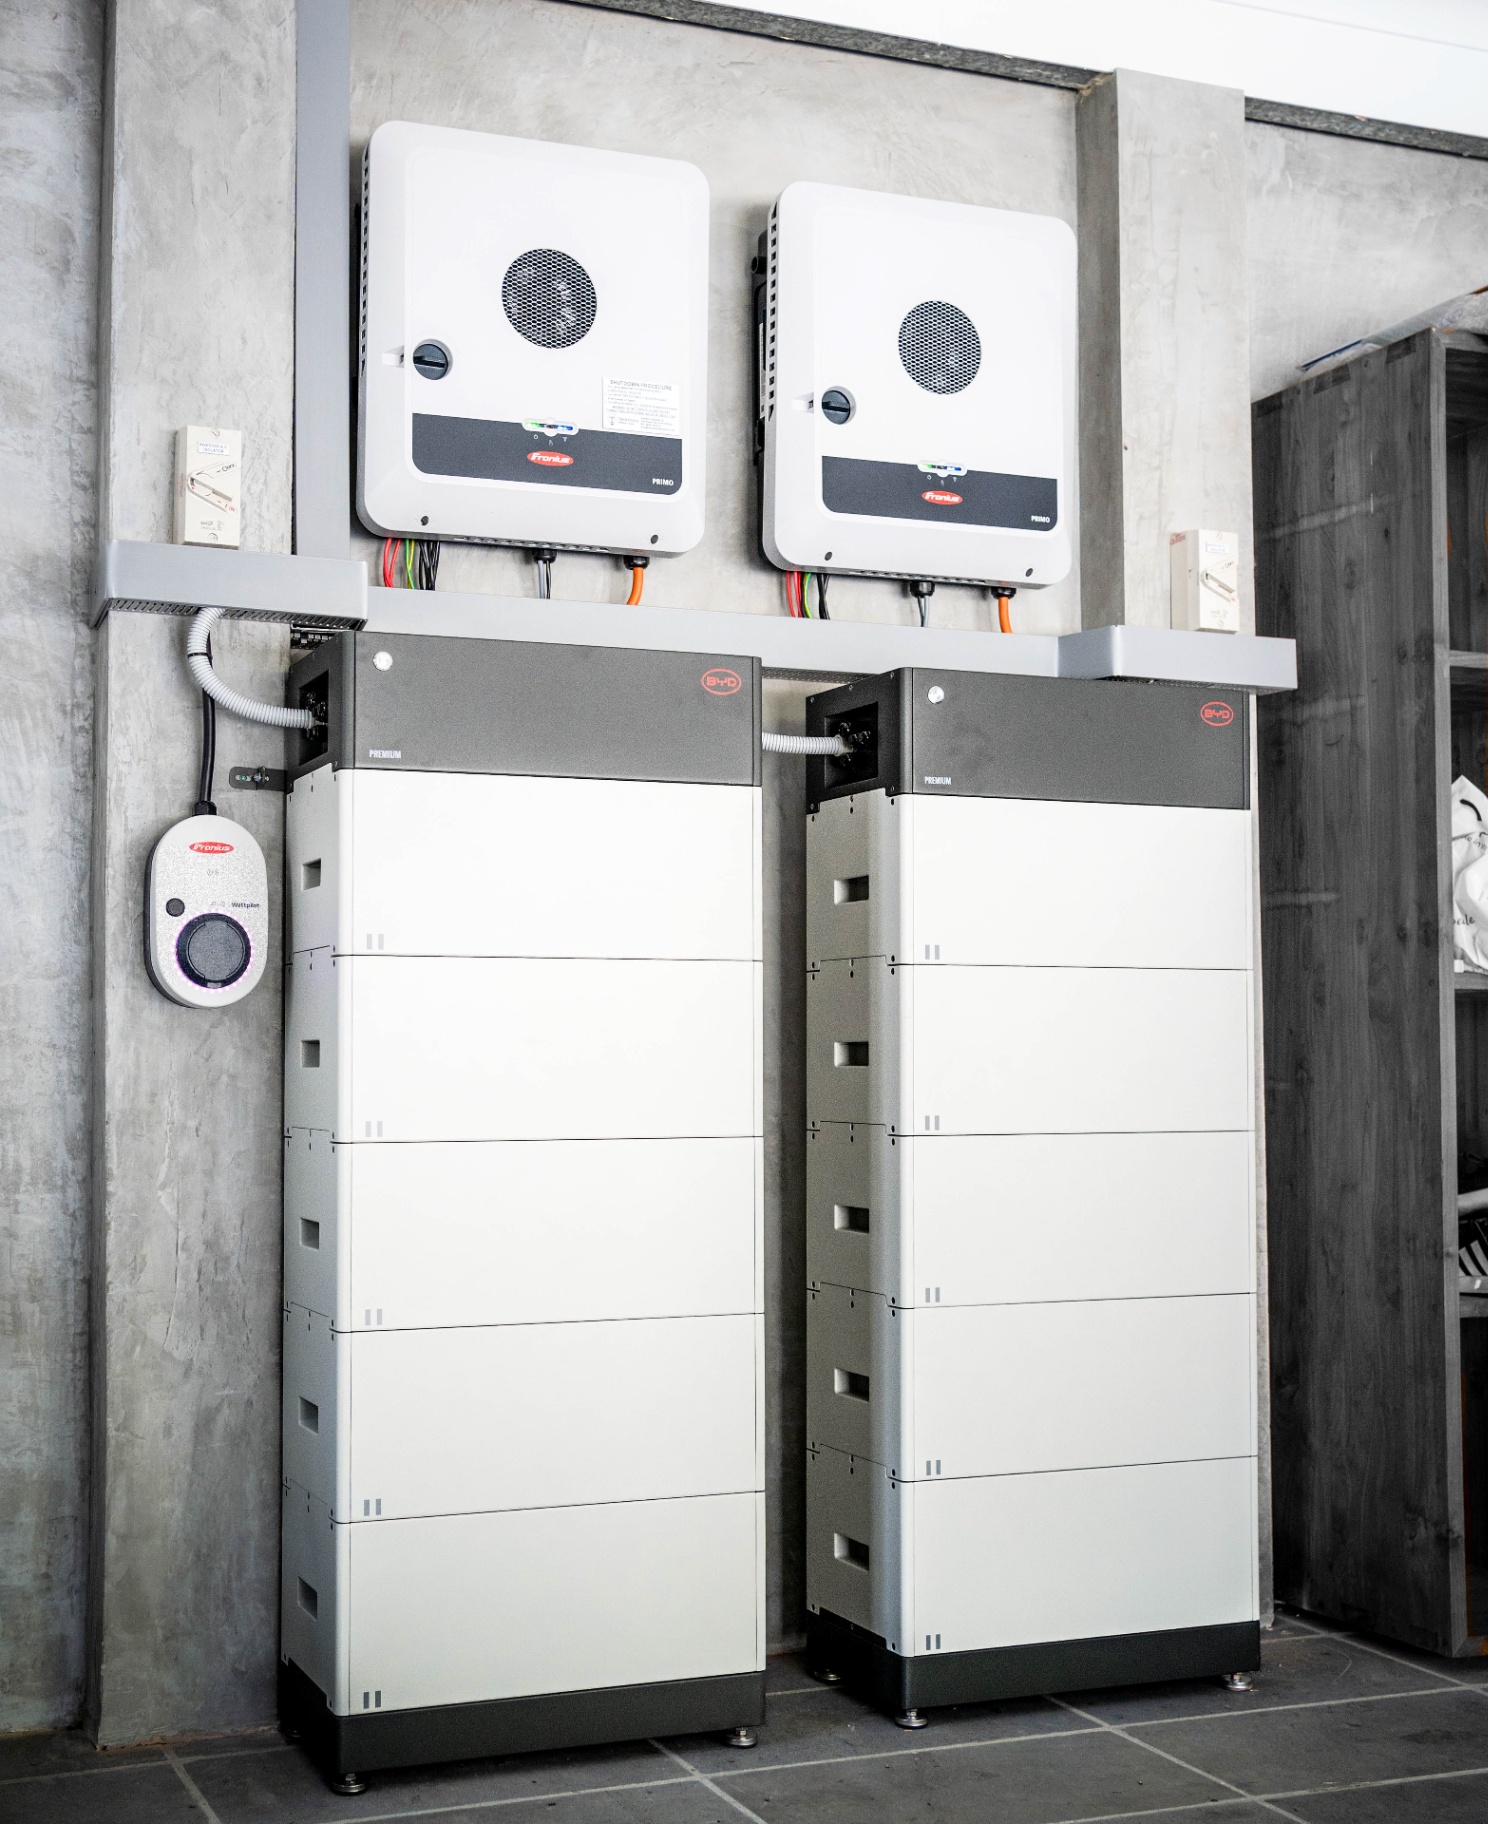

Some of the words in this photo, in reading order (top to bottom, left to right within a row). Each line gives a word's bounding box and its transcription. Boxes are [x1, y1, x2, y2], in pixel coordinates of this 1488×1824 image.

[530, 452, 571, 465] Fronius
[652, 477, 674, 487] PRIMO
[924, 491, 960, 503] Fronius
[1030, 515, 1051, 524] PRIMO
[706, 675, 737, 687] BYD
[1204, 708, 1230, 719] BYD
[368, 748, 402, 760] PREMIUM
[924, 775, 952, 787] PREMIUM
[193, 843, 230, 852] Fronius
